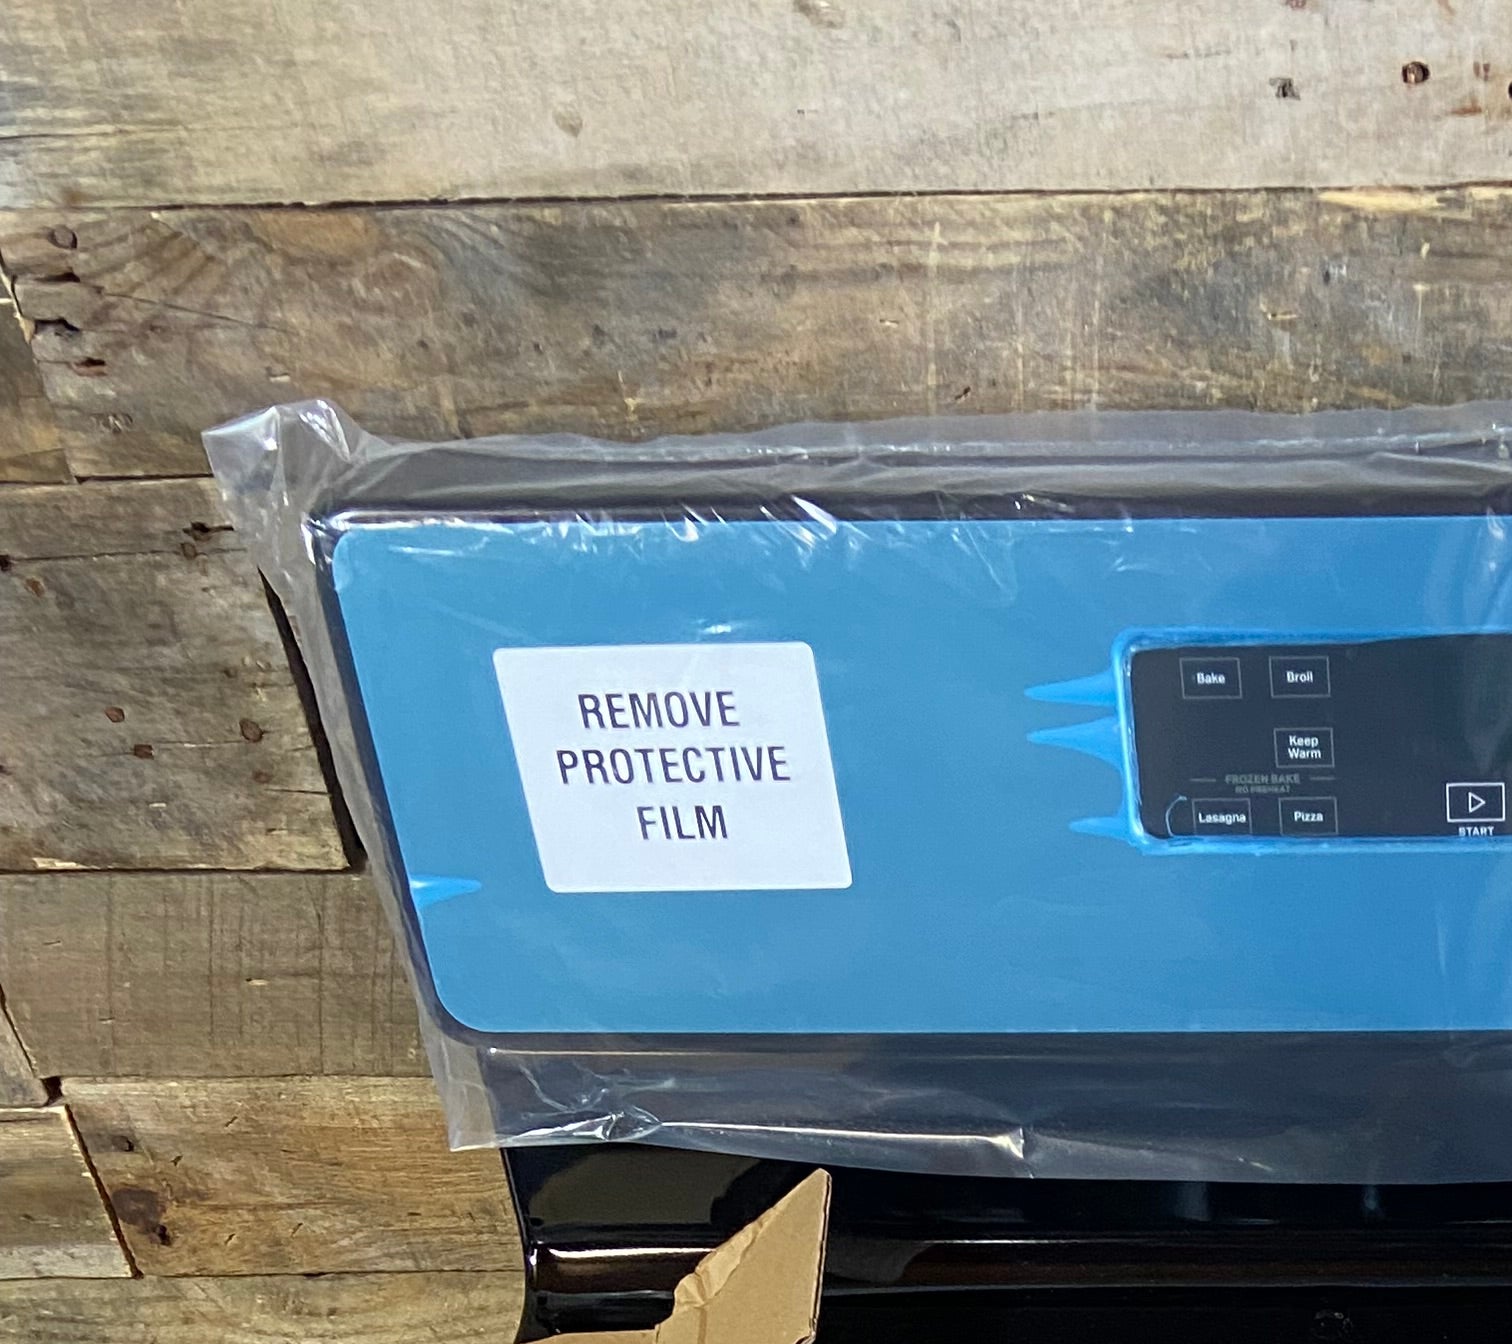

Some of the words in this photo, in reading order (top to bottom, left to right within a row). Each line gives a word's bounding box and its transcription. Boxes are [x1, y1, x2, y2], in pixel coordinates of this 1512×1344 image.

[1196, 672, 1226, 685] Bake
[1286, 670, 1313, 683] Broil
[577, 690, 741, 729] REMOVE
[1289, 735, 1319, 748] Keep
[1288, 747, 1322, 760] Warm
[556, 745, 791, 785] PROTECTIVE
[1225, 774, 1269, 785] FROZEN
[1270, 773, 1300, 784] BAKE
[636, 805, 728, 840] FILM
[1198, 812, 1247, 826] Lasagna
[1294, 811, 1324, 823] Pizza
[1458, 826, 1495, 837] START
